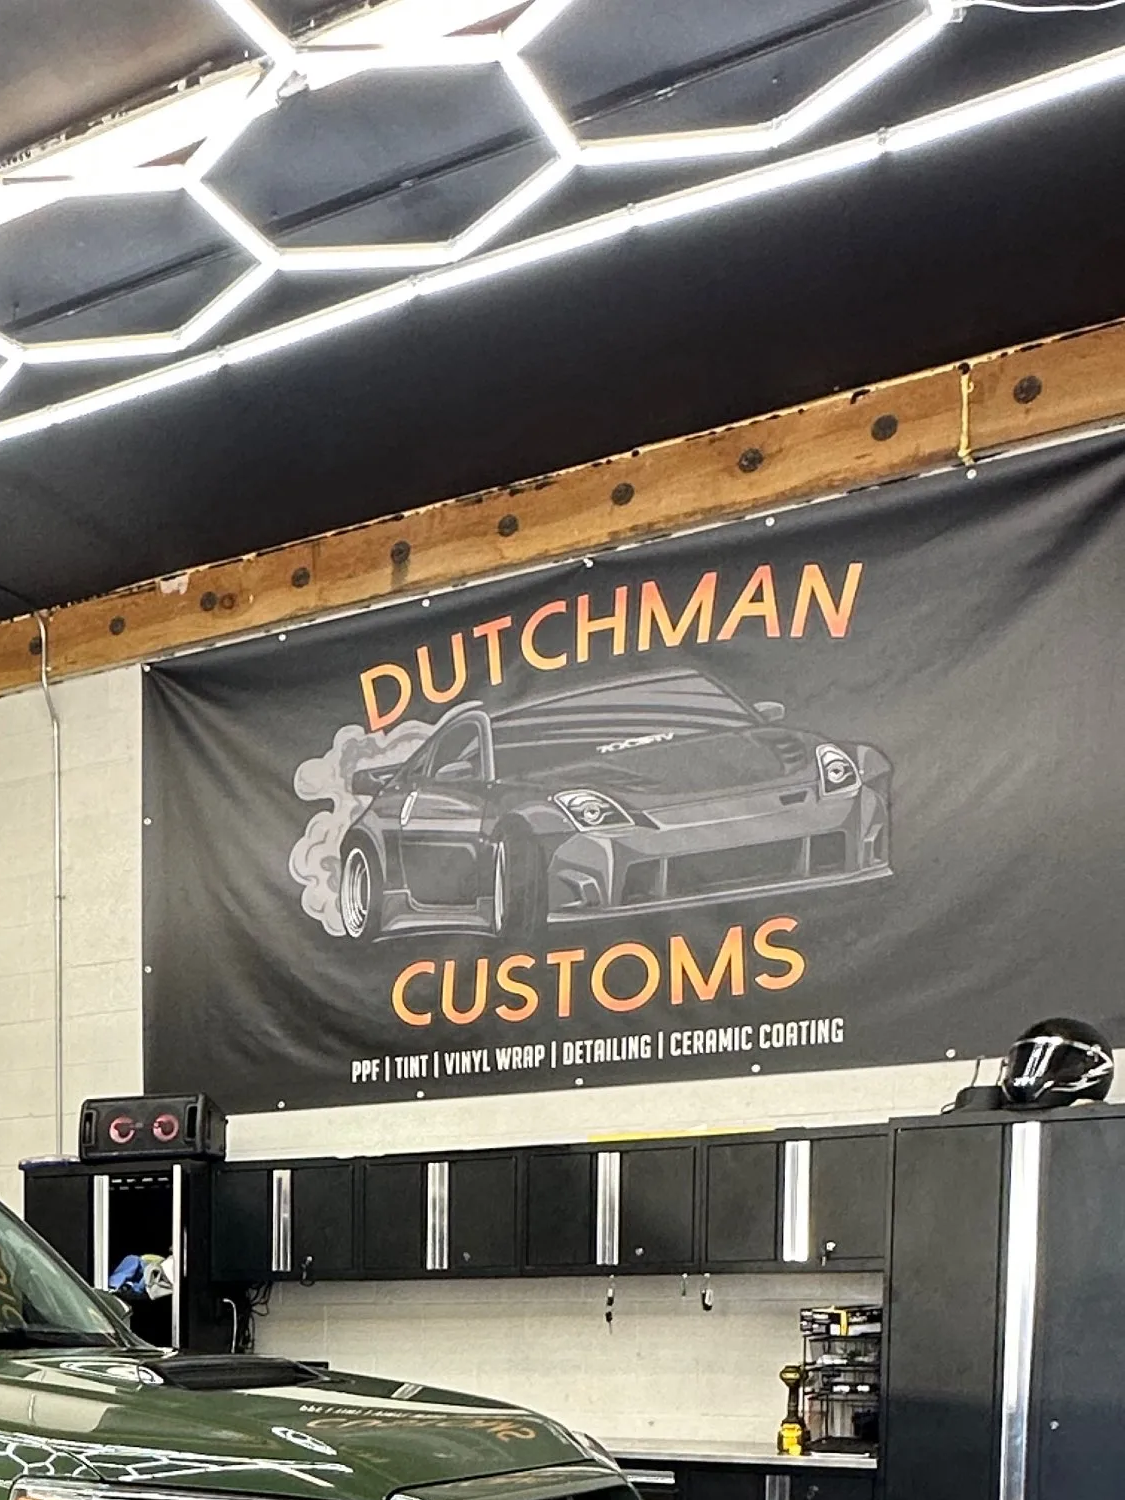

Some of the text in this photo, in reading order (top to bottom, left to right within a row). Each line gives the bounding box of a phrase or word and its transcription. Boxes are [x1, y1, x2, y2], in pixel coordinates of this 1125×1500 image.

[360, 562, 862, 734] DUTCHMAN
[391, 916, 806, 1026] CUSTOMS
[351, 1018, 844, 1083] PPF TINT VINYL WRAP DETAILING CERAMIC COATING
